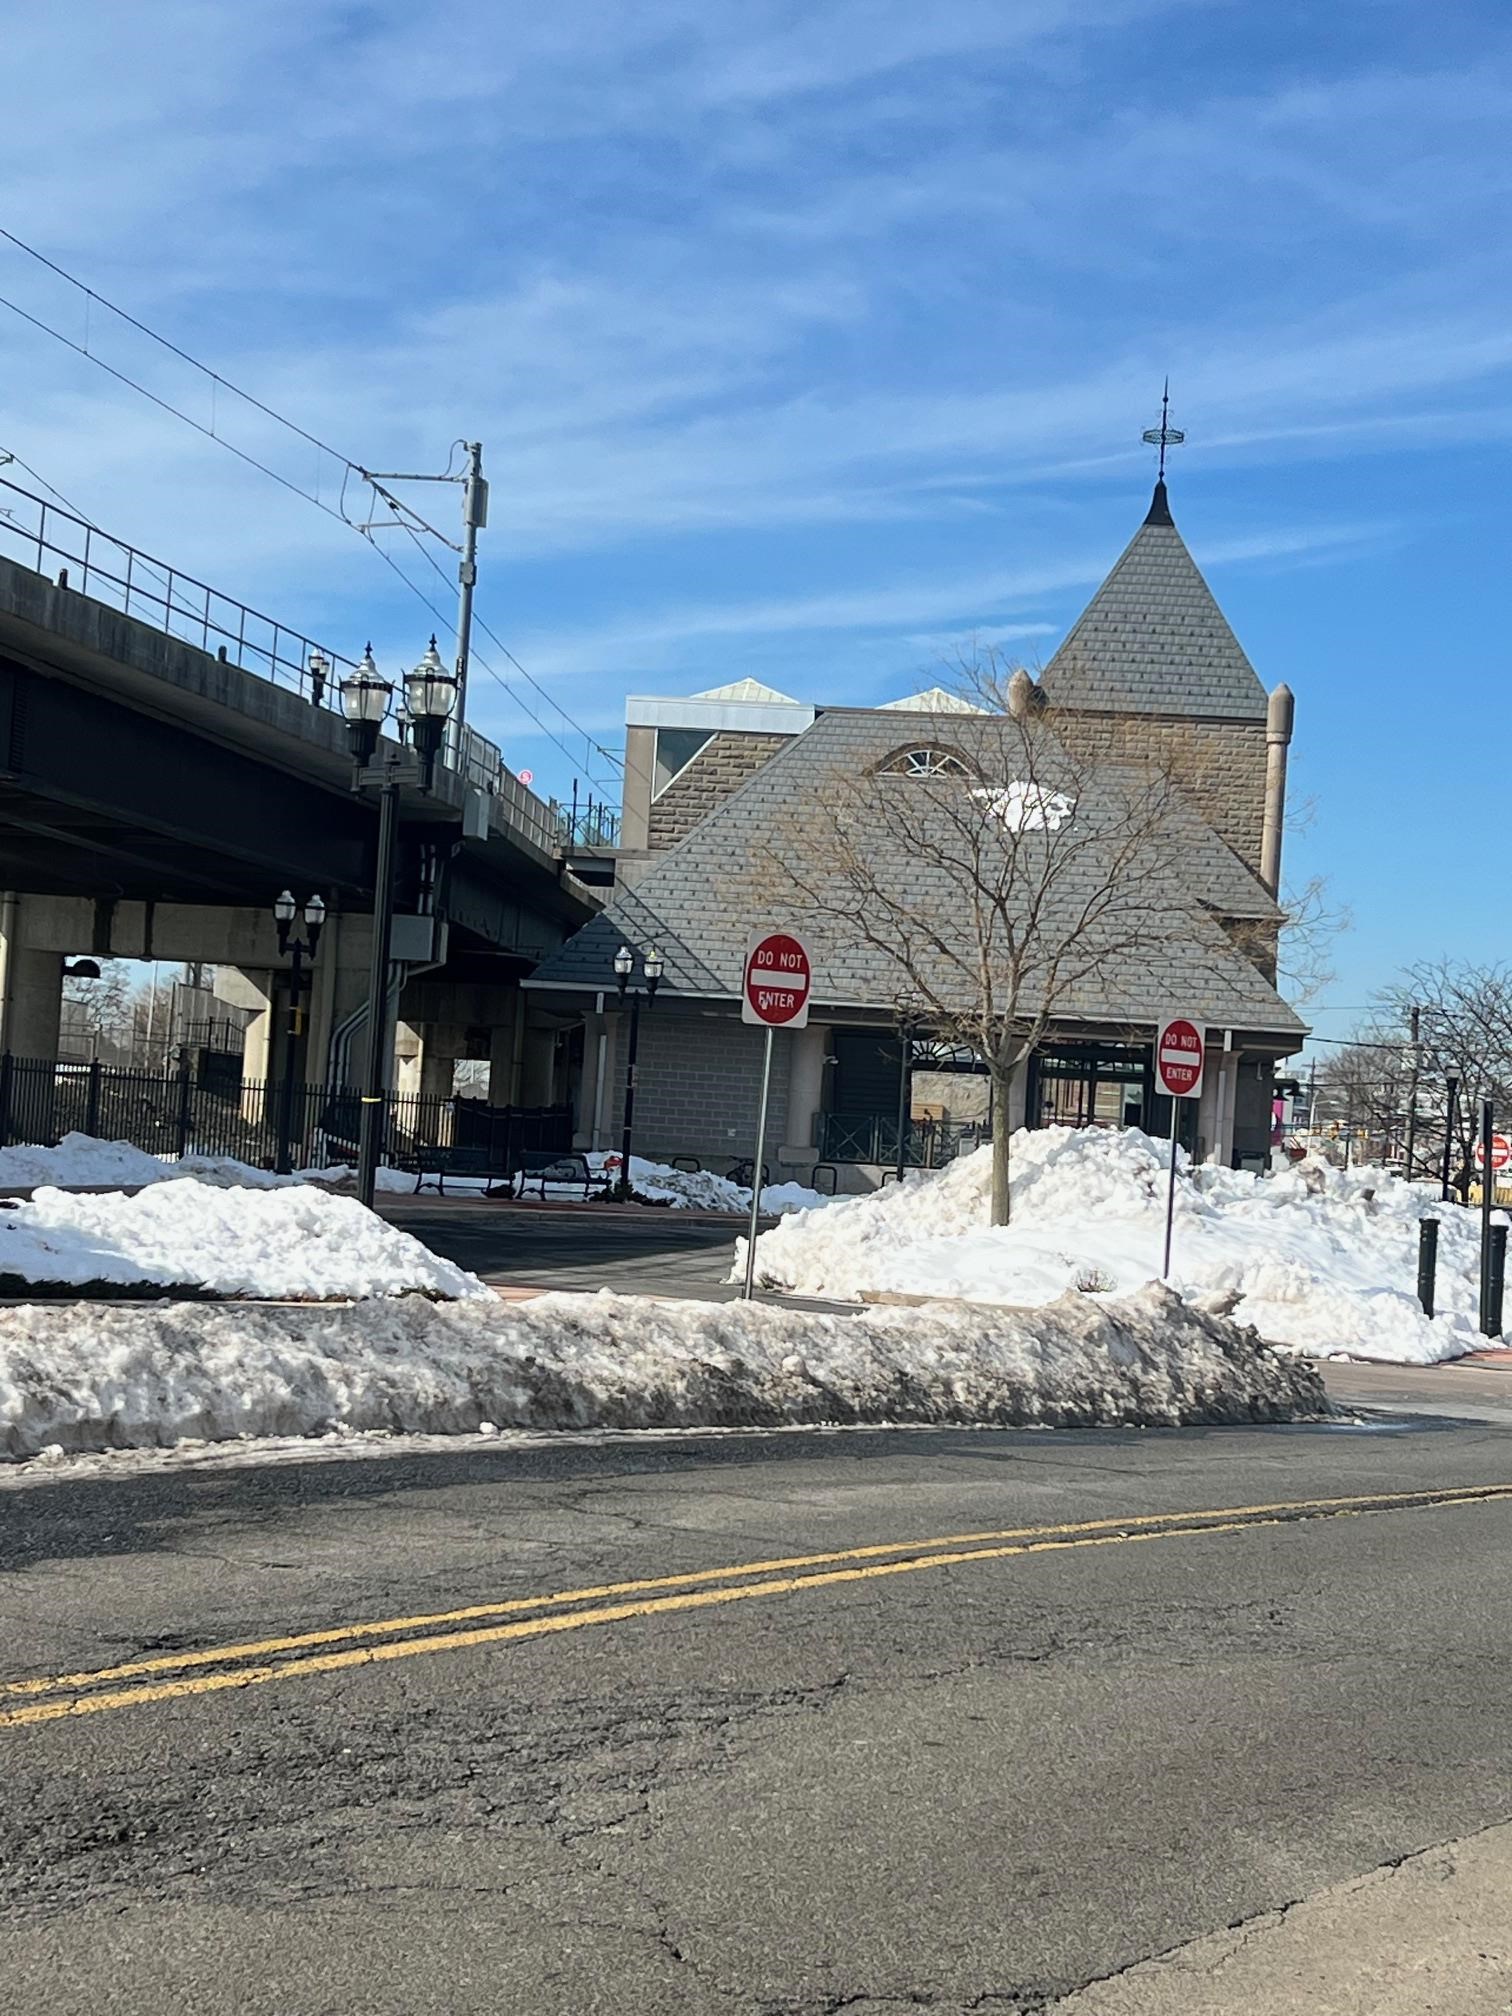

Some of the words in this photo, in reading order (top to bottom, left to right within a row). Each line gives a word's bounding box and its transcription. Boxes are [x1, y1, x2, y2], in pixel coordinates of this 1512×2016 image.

[757, 950, 774, 965] DO
[780, 952, 803, 969] NOT
[758, 991, 795, 1009] ENTER
[1165, 1033, 1177, 1046] DO
[1180, 1035, 1198, 1048] NOT
[1166, 1066, 1193, 1081] ENTER
